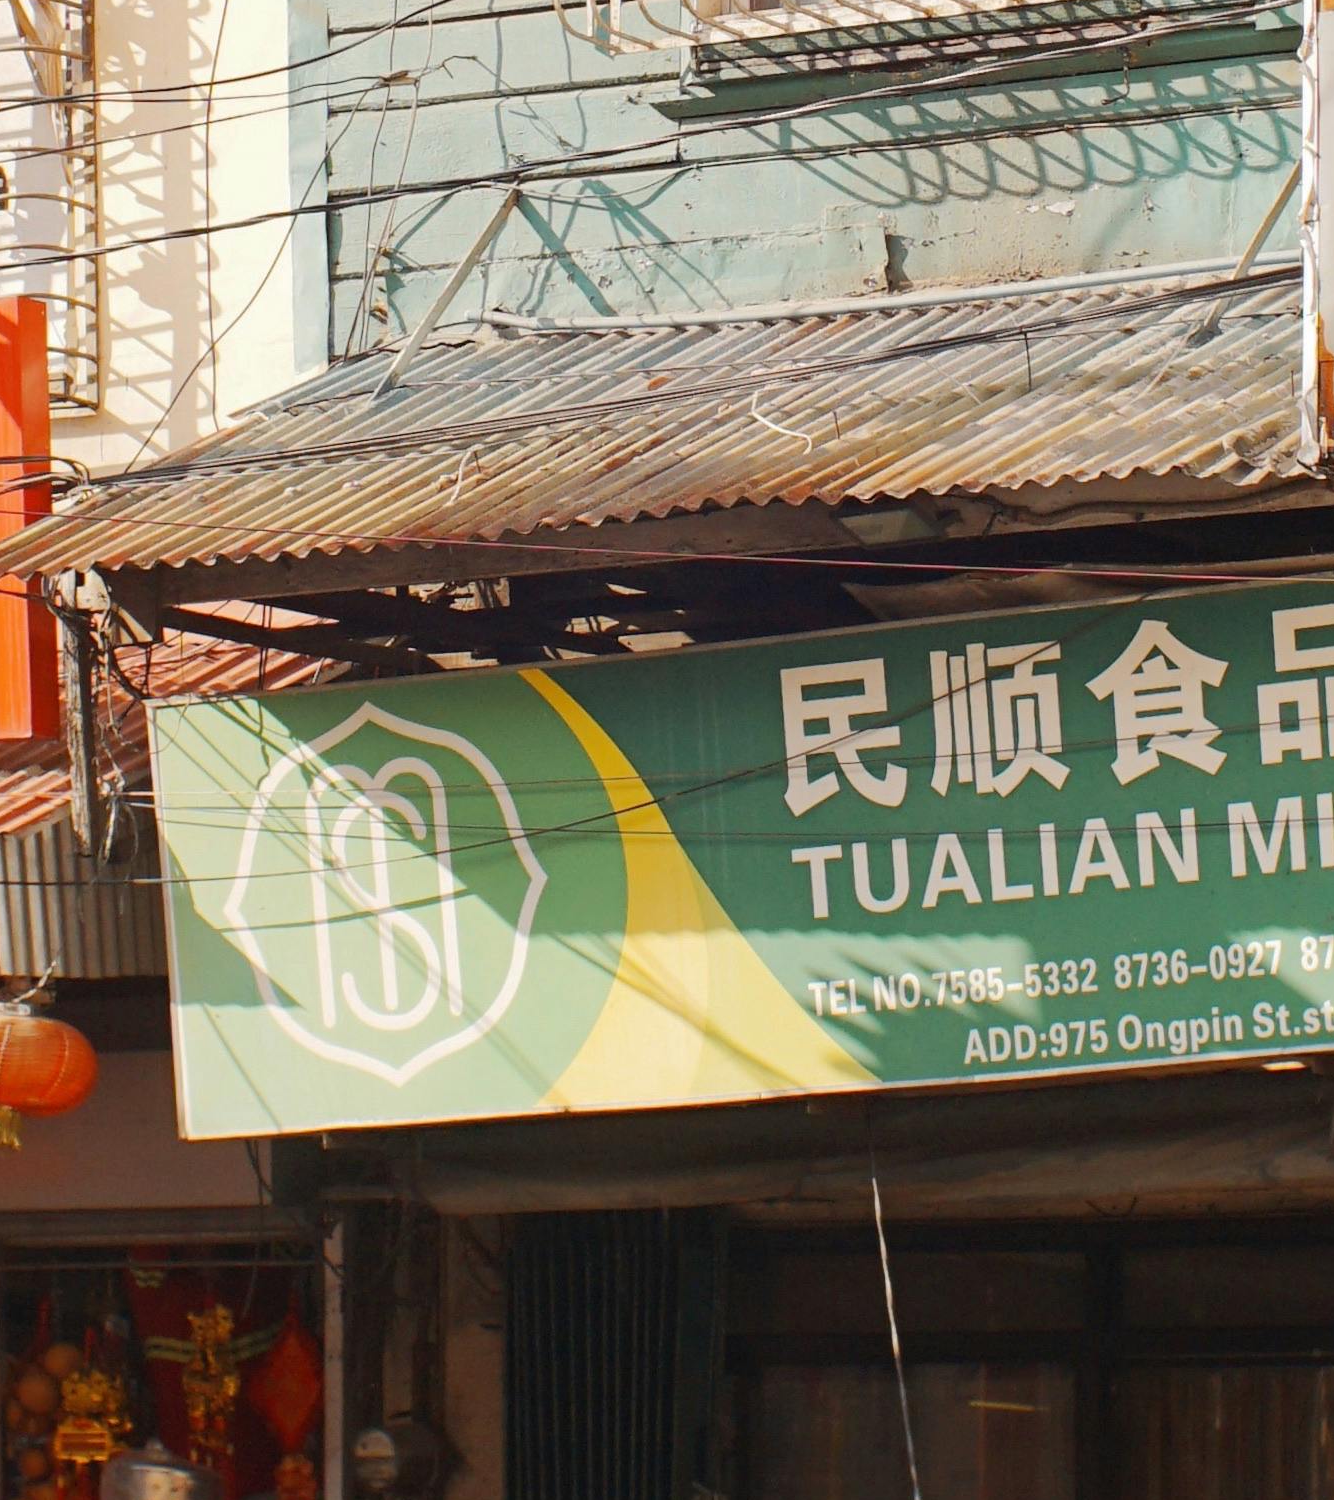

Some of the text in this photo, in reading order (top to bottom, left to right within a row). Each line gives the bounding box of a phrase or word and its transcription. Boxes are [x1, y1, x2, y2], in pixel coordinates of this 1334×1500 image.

[790, 807, 1201, 919] TUALIAN
[807, 979, 867, 1018] TEL
[1113, 939, 1284, 990] 8736-0927
[963, 1018, 1109, 1066] ADD:975
[1117, 1006, 1244, 1055] Ongpin
